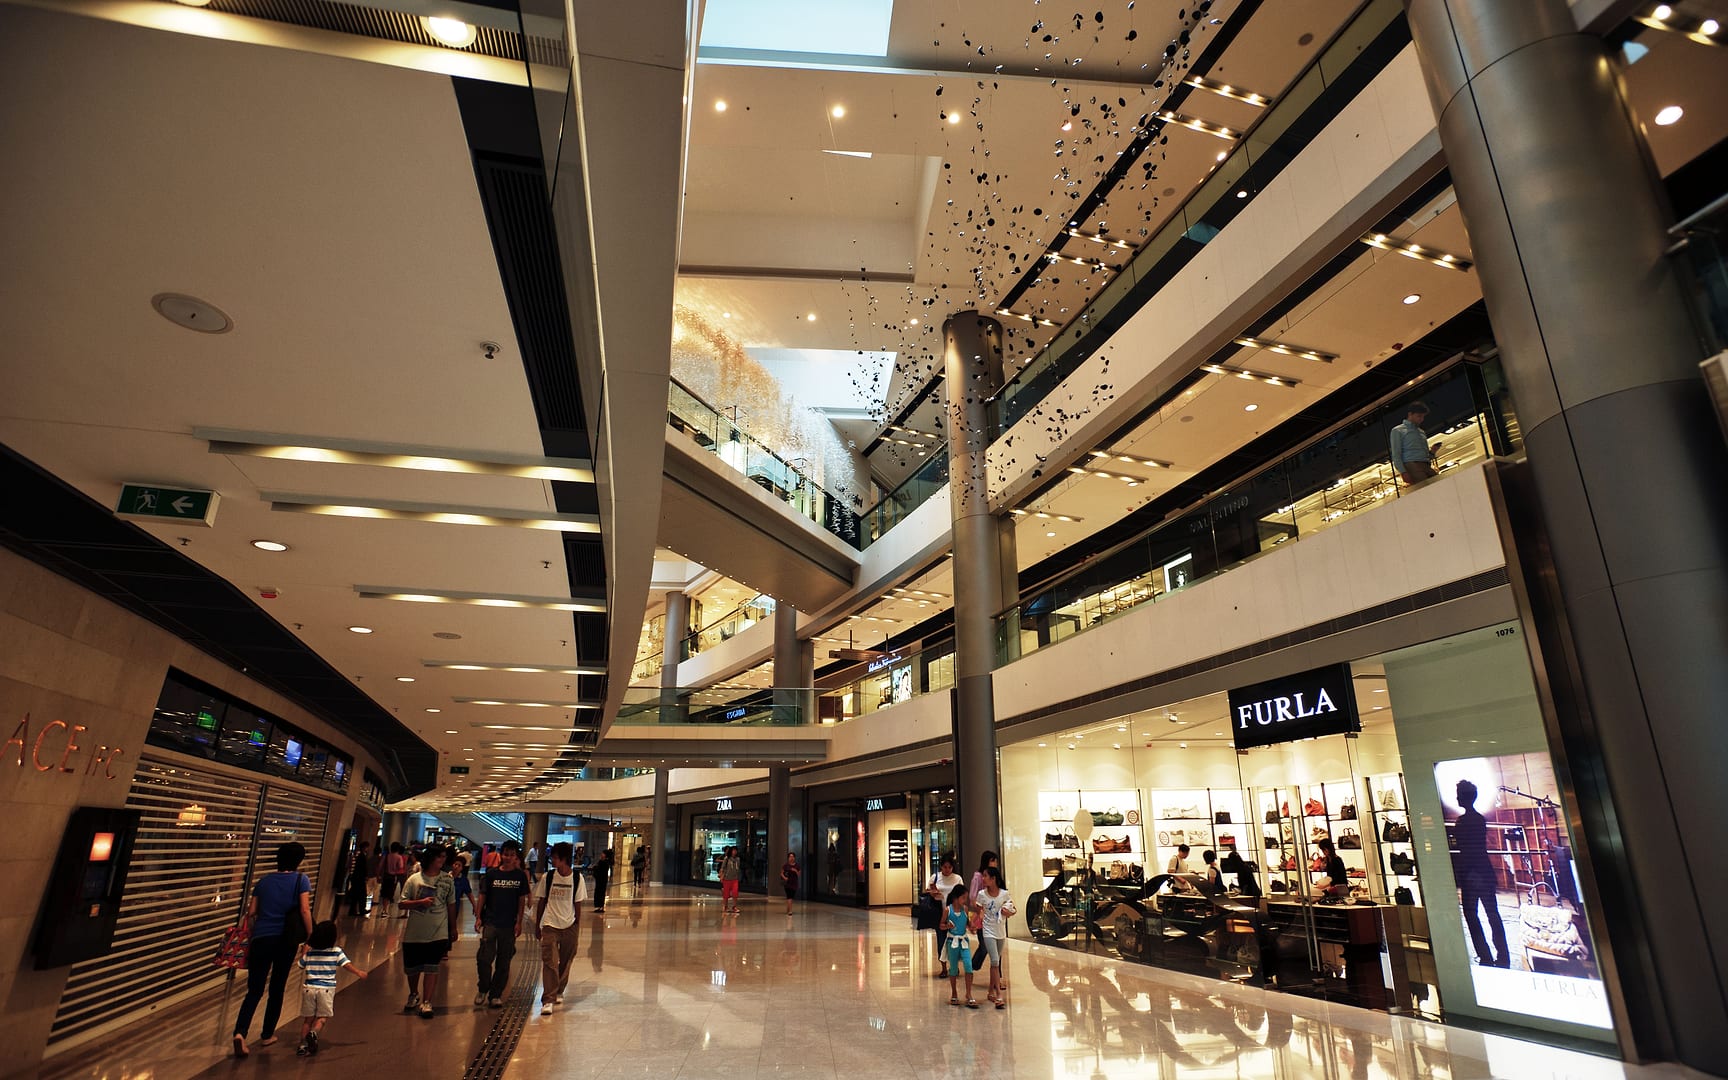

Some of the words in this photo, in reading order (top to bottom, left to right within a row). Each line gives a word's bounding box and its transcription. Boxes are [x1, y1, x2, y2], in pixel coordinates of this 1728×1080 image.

[1189, 495, 1249, 535] VALNTINO
[1495, 626, 1515, 638] 1076
[1237, 687, 1338, 729] FURLA
[0, 711, 88, 774] ACE
[84, 744, 125, 780] IFC
[716, 799, 733, 811] ZARA
[866, 798, 883, 811] ZARA
[1531, 976, 1598, 1000] FURLA
